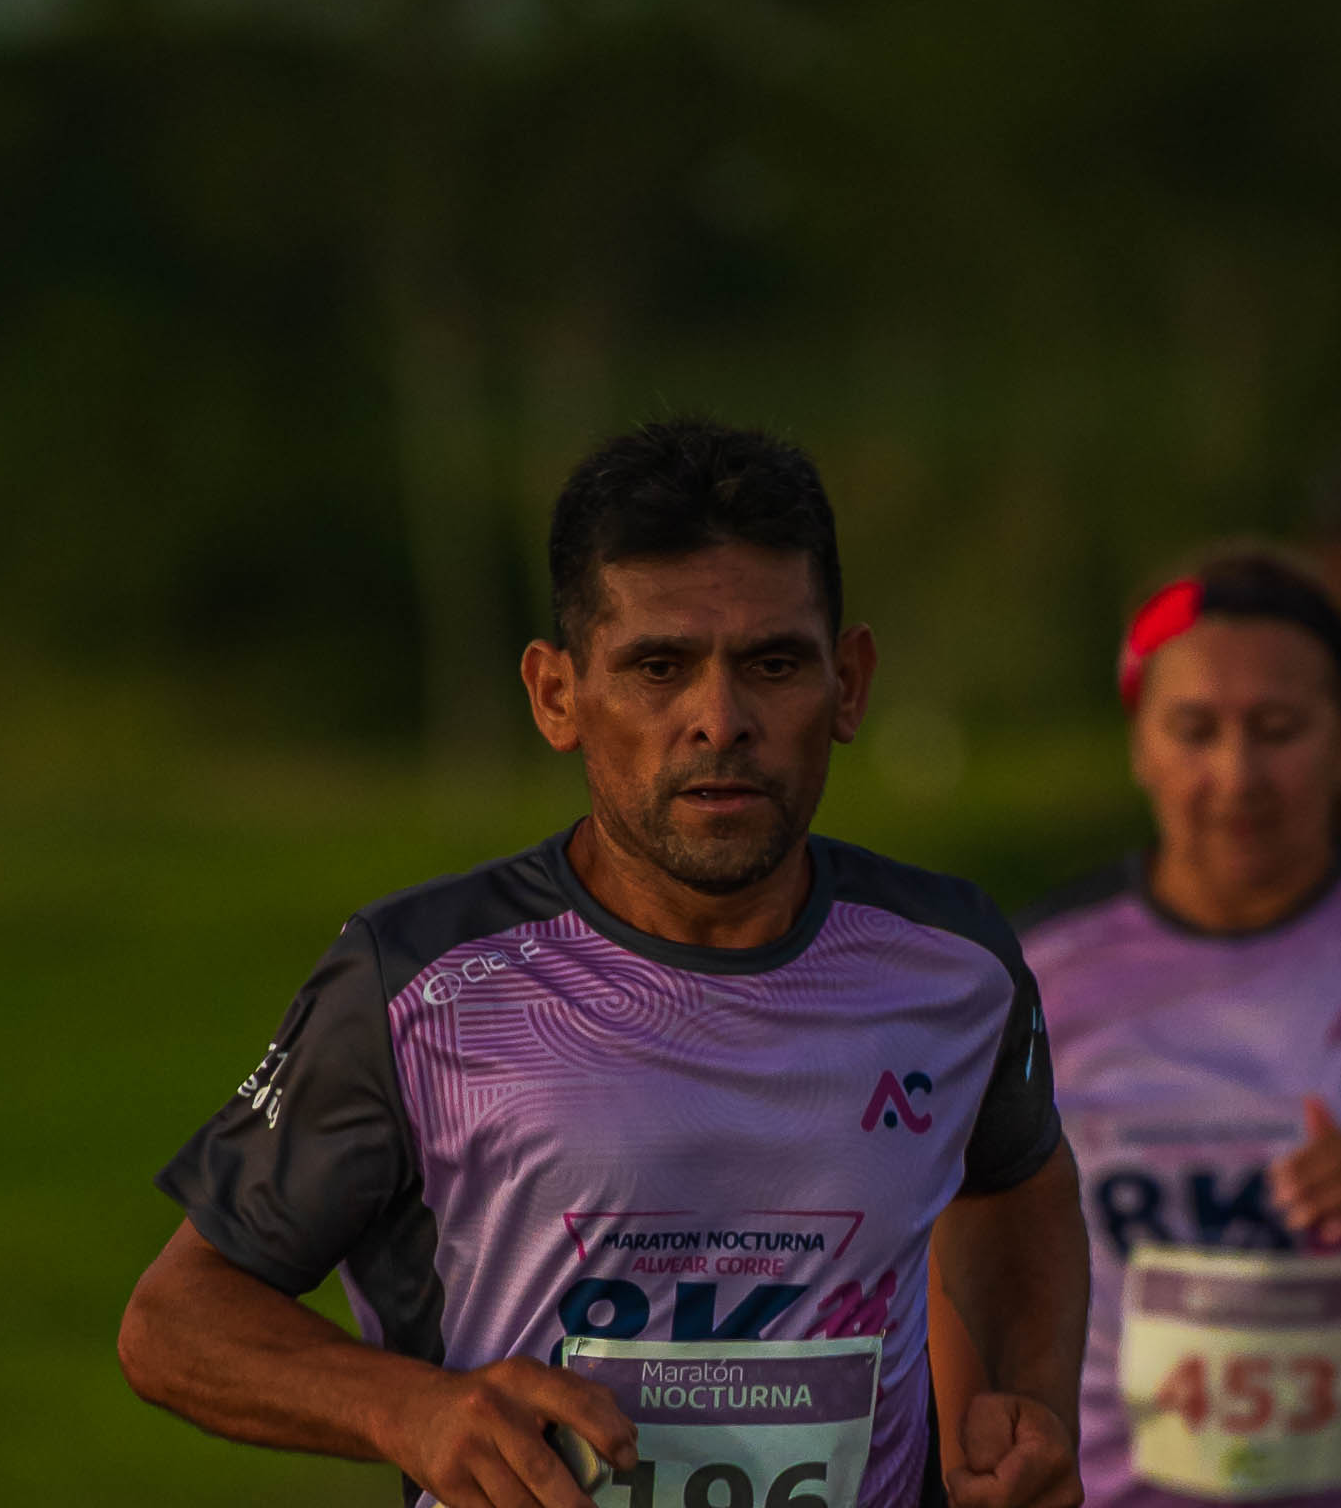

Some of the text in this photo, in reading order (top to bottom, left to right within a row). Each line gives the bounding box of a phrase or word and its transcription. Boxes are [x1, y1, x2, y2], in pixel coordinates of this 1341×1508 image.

[602, 1231, 825, 1252] MARATON NOCTURNA
[632, 1256, 785, 1277] ALVEAR CORRE
[641, 1359, 744, 1384] Maratón
[640, 1385, 812, 1410] NOCTURNA
[1154, 1354, 1338, 1431] 453
